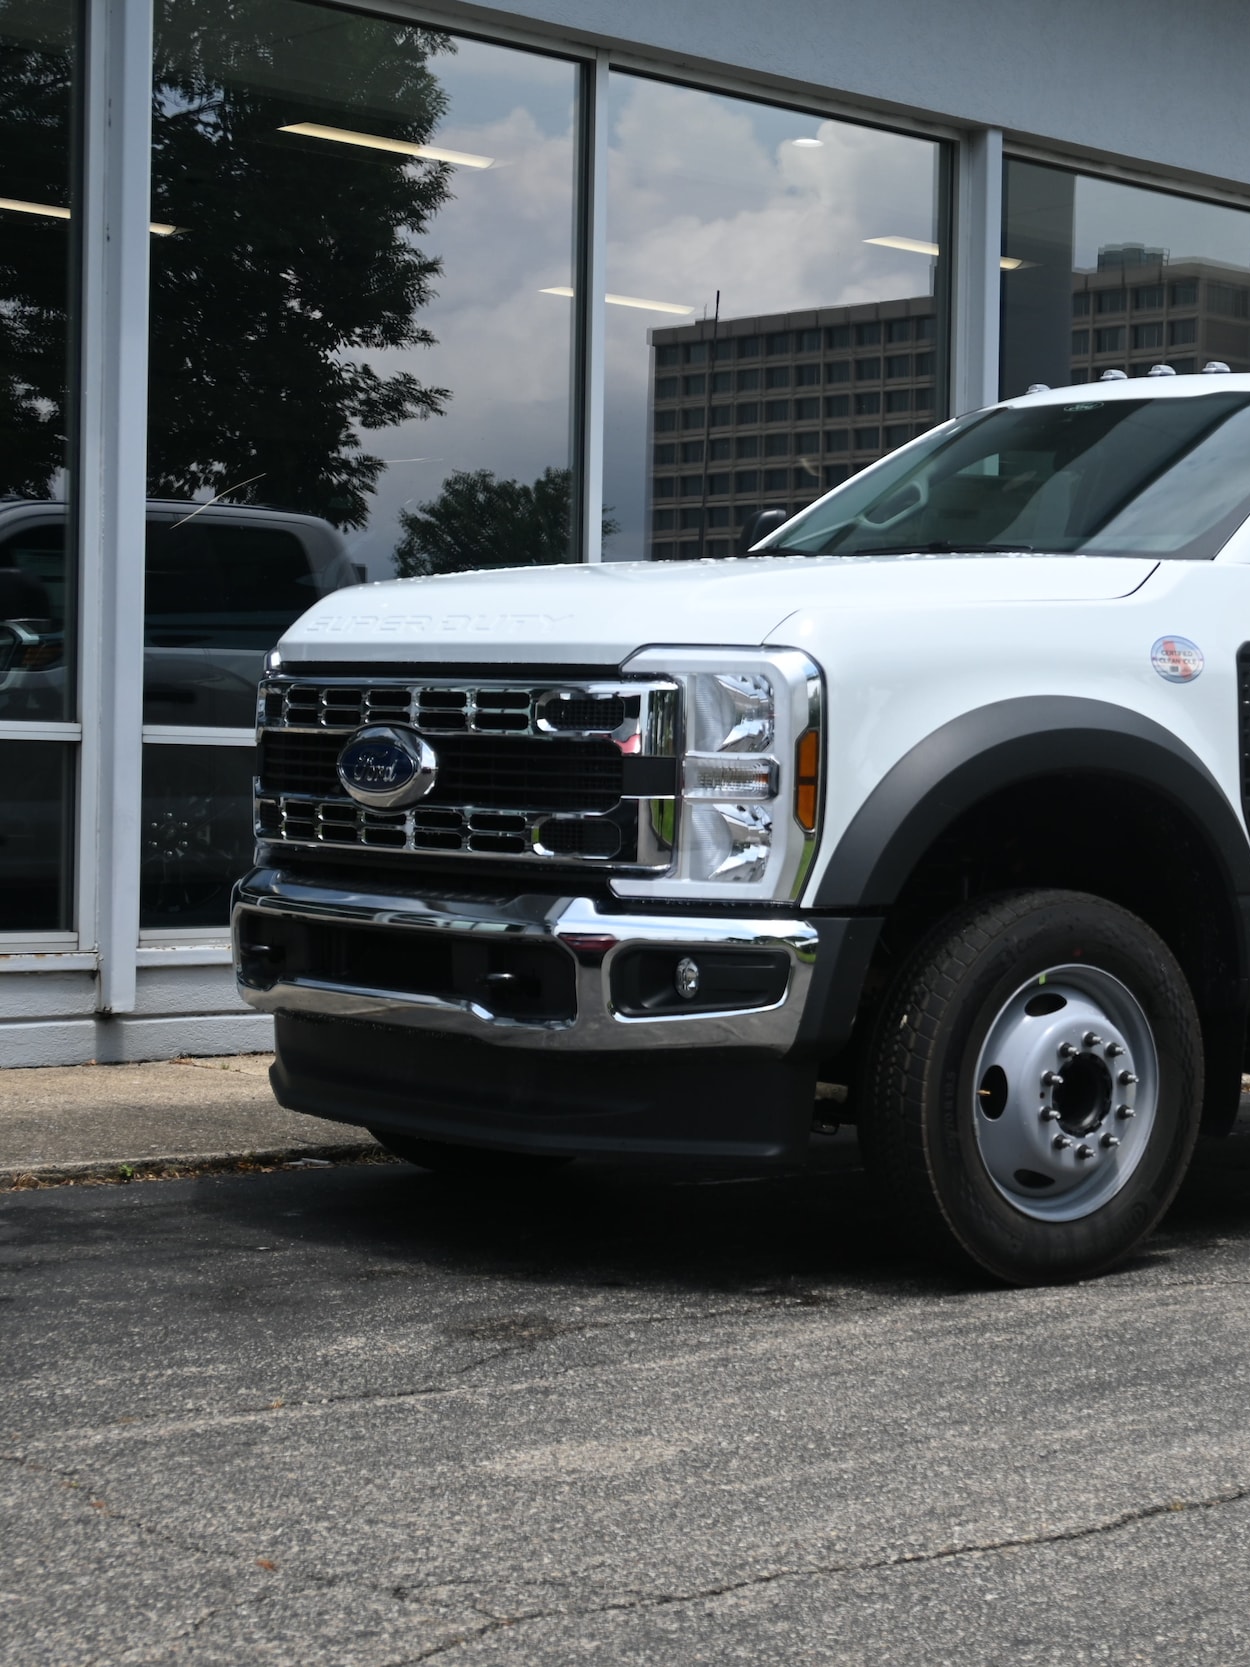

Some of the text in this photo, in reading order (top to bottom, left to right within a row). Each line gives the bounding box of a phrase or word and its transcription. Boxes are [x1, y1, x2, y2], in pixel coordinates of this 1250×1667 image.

[305, 613, 575, 634] SUPER DUTY
[1160, 649, 1193, 657] CERTIFIED
[1158, 657, 1181, 665] CLEAN
[353, 748, 398, 782] Ford
